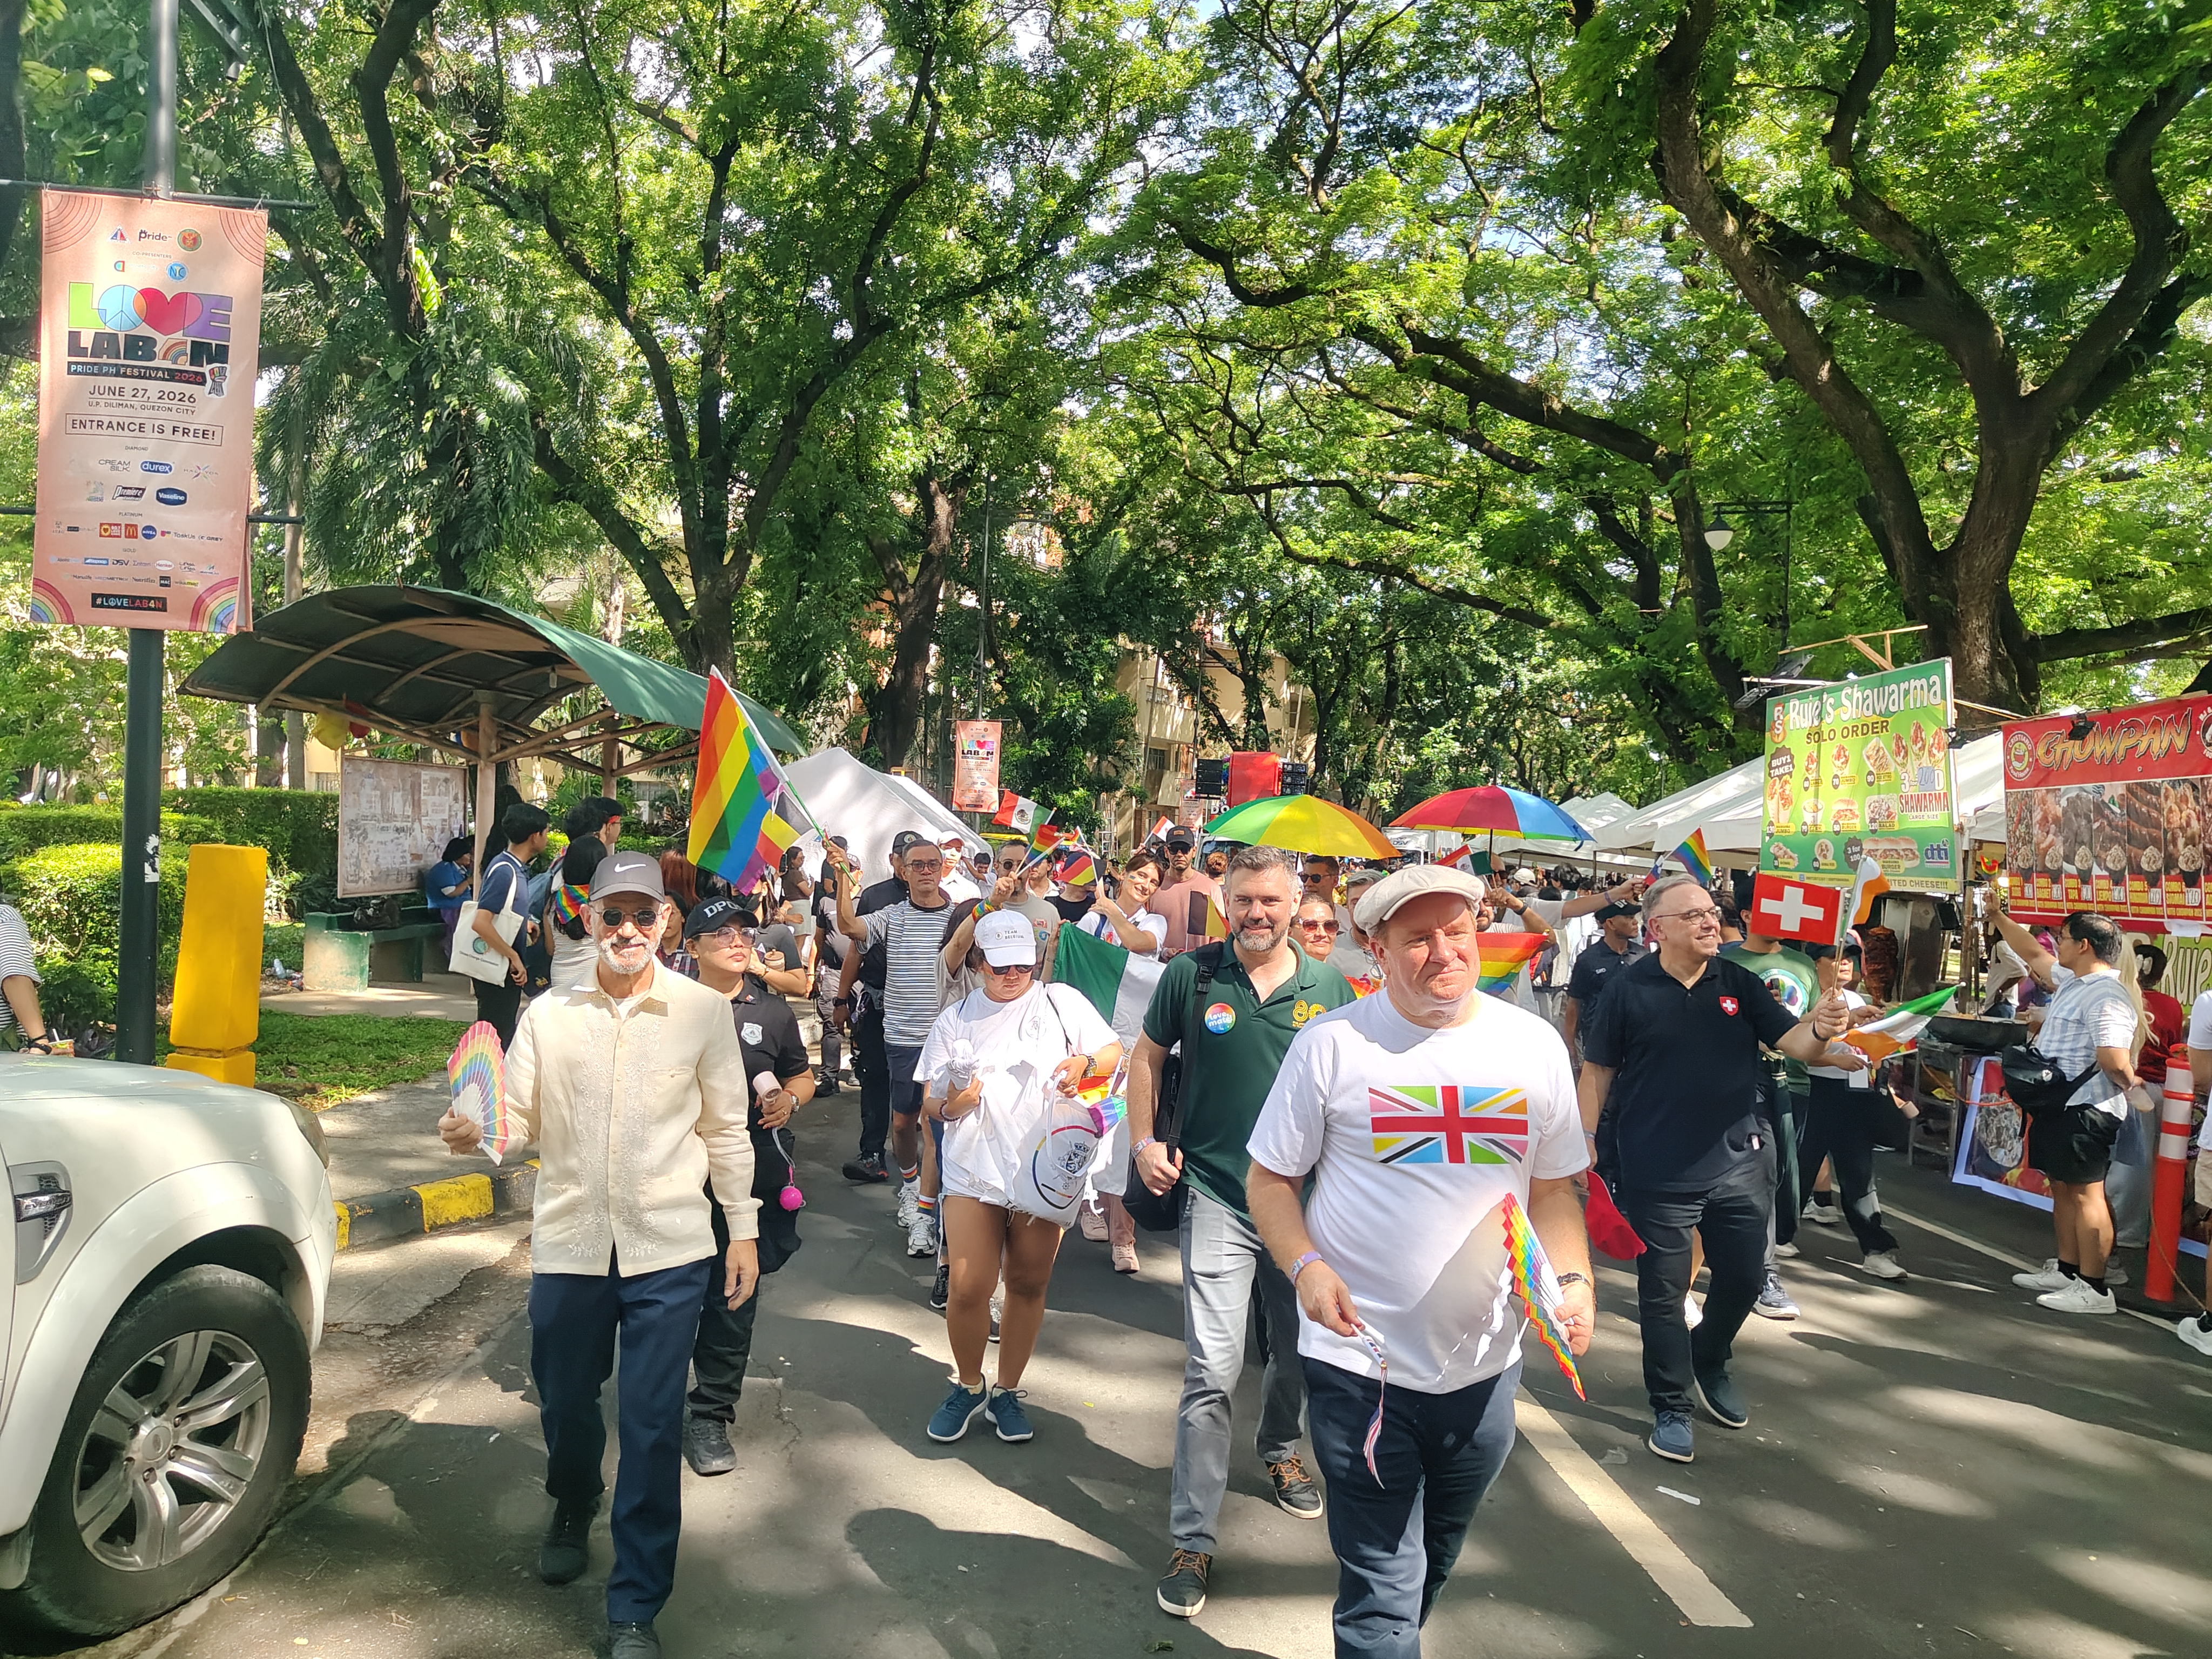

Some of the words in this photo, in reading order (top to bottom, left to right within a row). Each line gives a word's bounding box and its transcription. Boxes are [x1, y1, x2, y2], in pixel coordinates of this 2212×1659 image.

[132, 251, 172, 259] CO-PRESENTERS
[71, 364, 99, 374] PRIDE
[120, 367, 170, 379] FESTIVAL
[174, 372, 203, 382] 2026
[89, 385, 126, 397] JUNE
[131, 387, 151, 401] 27,
[157, 390, 197, 404] 2026
[104, 402, 138, 410] DILIMAN,
[140, 404, 173, 412] QUEZON
[176, 408, 196, 416] CITY
[71, 419, 146, 433] ENTRANCE
[152, 423, 165, 434] IS
[172, 426, 215, 440] FREE!
[141, 462, 171, 473] durex
[158, 492, 185, 501] Vaseline
[1789, 691, 1835, 731] Ruie's
[1840, 675, 1941, 722] Shawarma
[1805, 727, 1836, 745] SOLO
[1840, 719, 1890, 740] ORDER
[2008, 734, 2032, 750] CRISTIANO
[1918, 767, 1934, 786] 200
[2009, 765, 2019, 778] Food
[1900, 772, 1910, 793] 3
[1899, 792, 1950, 813] SHAWARMA
[1850, 853, 1861, 861] 100
[1910, 880, 1948, 889] CHEESE!!!
[2113, 887, 2125, 901] 120
[2186, 889, 2200, 904] 120
[1208, 1014, 1233, 1027] mate!
